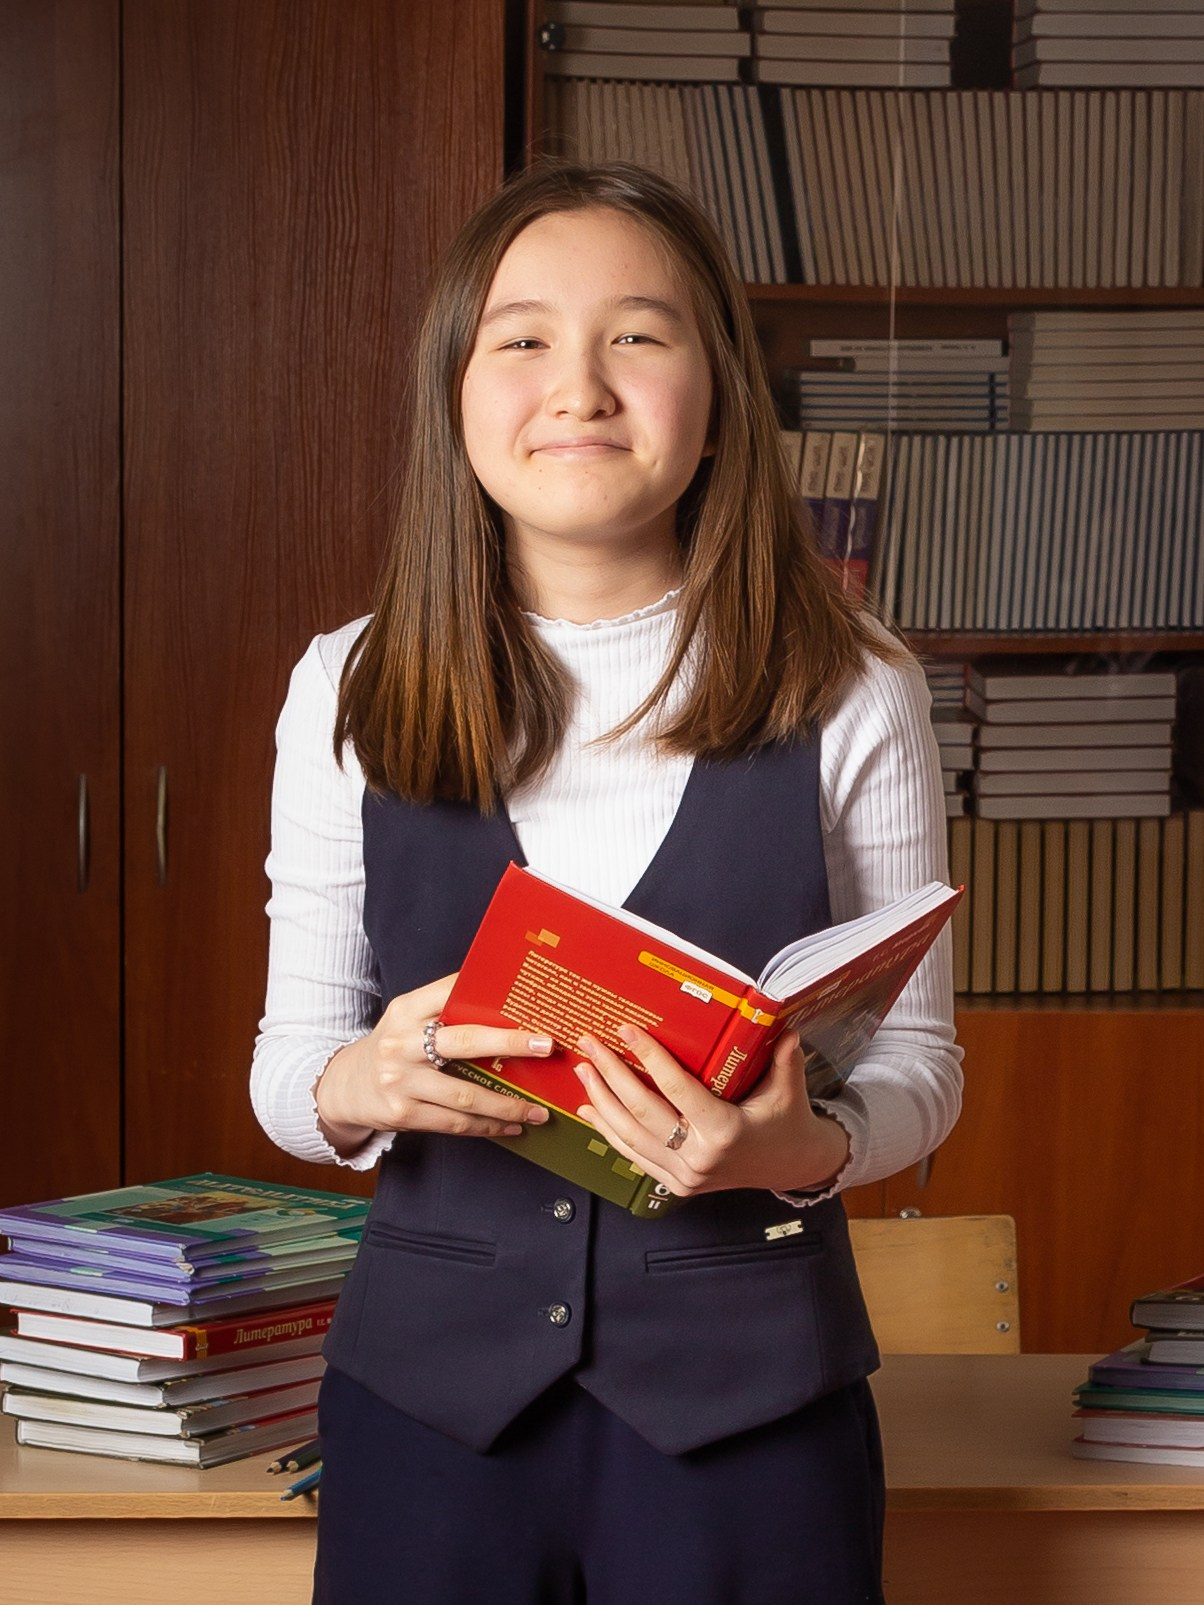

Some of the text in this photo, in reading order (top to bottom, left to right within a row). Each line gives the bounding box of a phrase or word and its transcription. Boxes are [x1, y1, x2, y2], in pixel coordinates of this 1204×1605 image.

[651, 957, 715, 991] ИННОВАЦИОННАЯ
[684, 984, 709, 999] ФГОС
[233, 1318, 313, 1345] Литература
